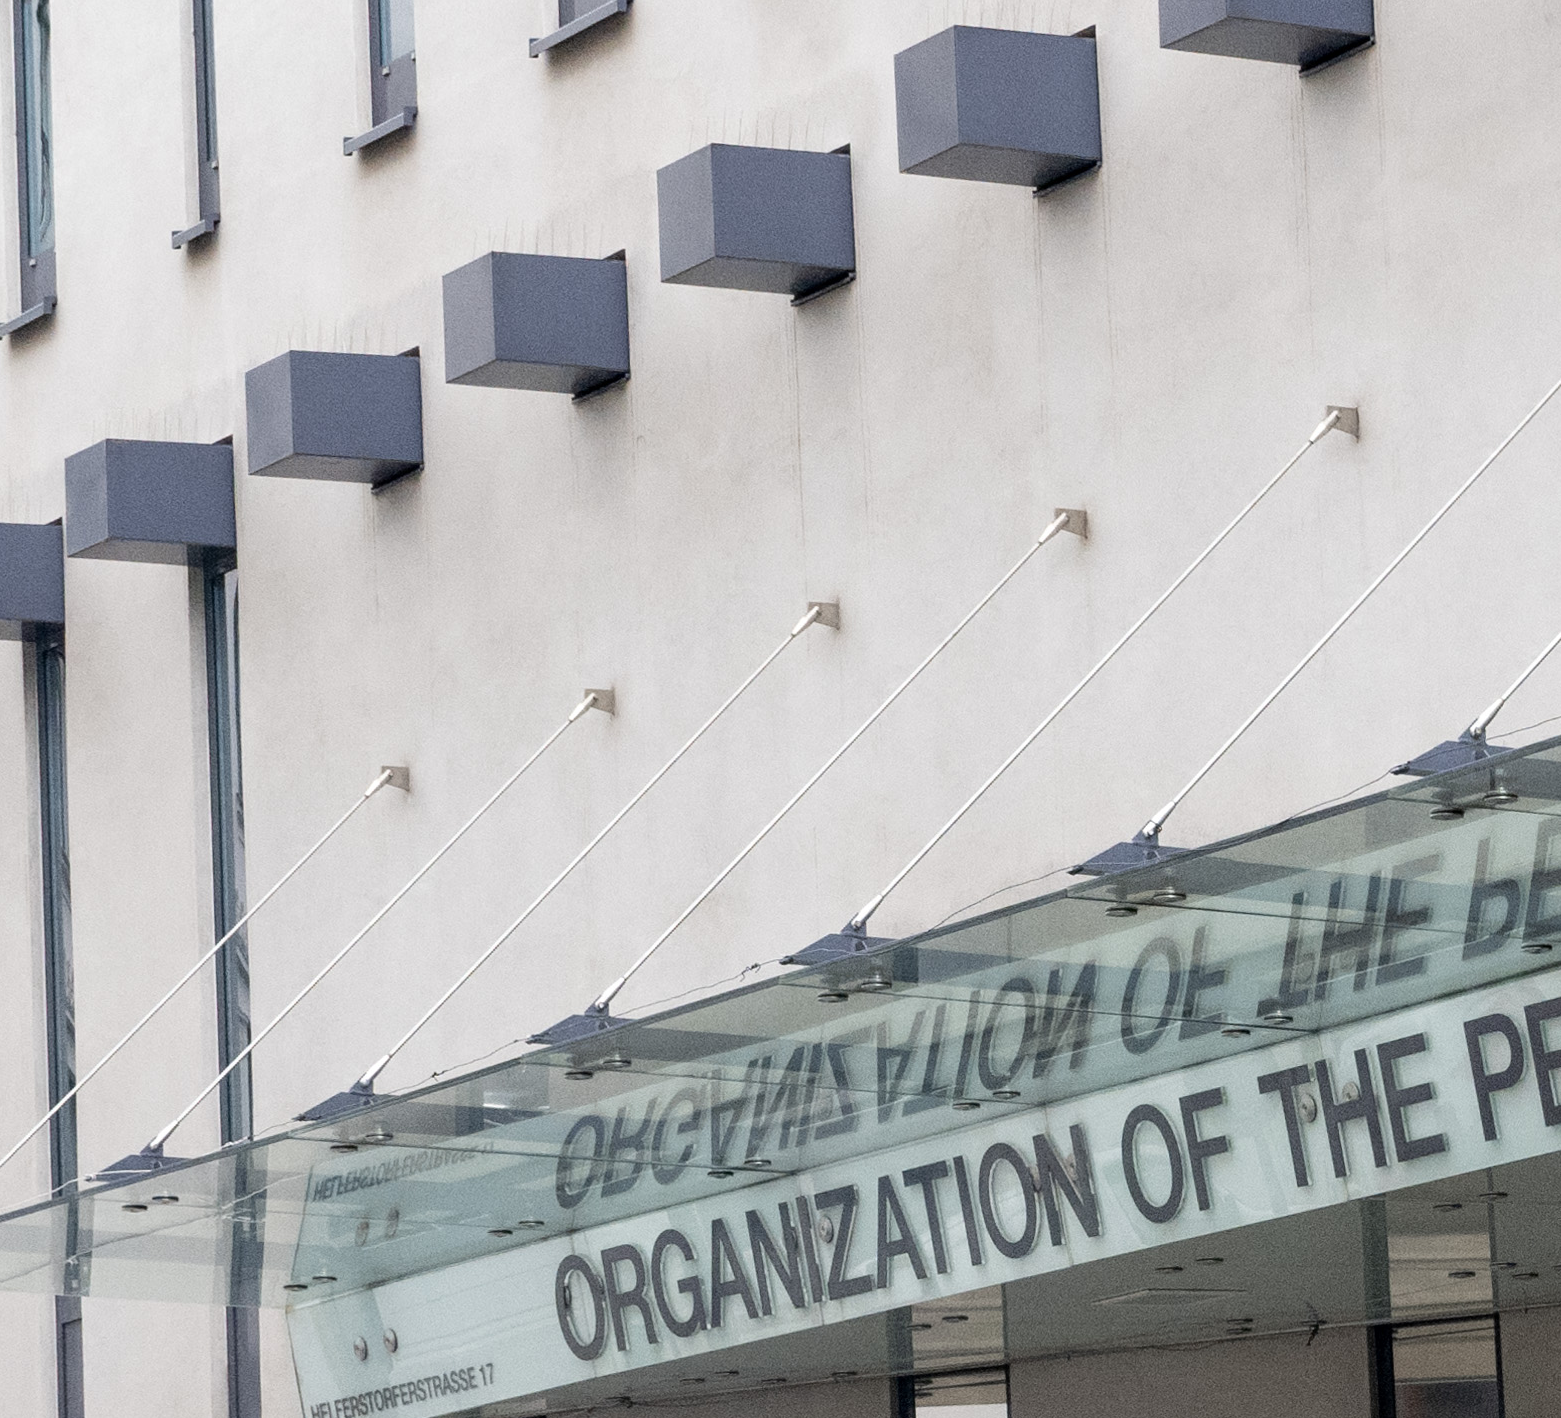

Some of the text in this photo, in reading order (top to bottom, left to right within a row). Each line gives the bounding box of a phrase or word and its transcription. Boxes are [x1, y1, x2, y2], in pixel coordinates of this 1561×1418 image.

[554, 1122, 1105, 1362] ORGANIZATION
[1121, 1086, 1231, 1224] OF
[1257, 1032, 1449, 1187] THE
[479, 1363, 495, 1385] 17
